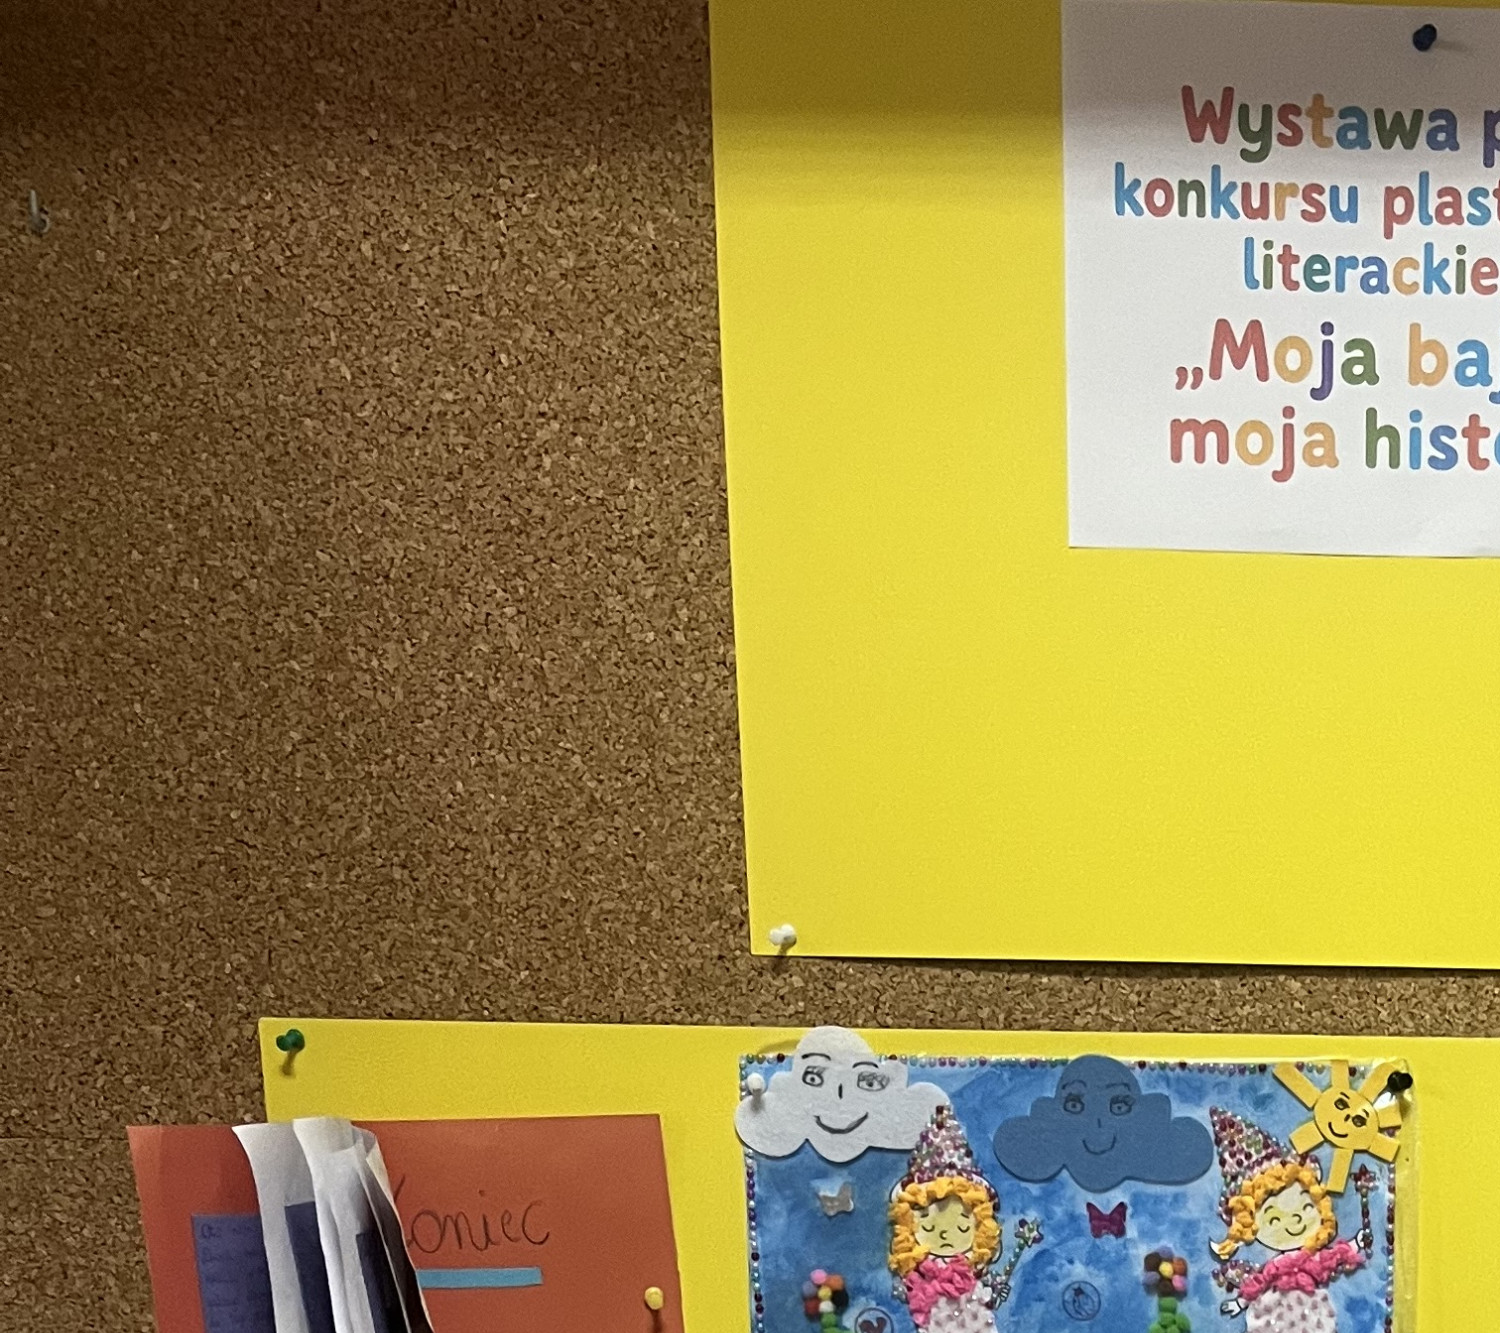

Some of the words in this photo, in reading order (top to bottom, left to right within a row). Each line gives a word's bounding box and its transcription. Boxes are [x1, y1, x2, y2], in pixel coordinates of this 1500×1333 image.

[1181, 86, 1459, 162] Wystawa
[1114, 162, 1358, 224] konkursu
[1175, 318, 1379, 401] „Moja
[1170, 405, 1339, 482] moja
[394, 1176, 549, 1253] oniec
